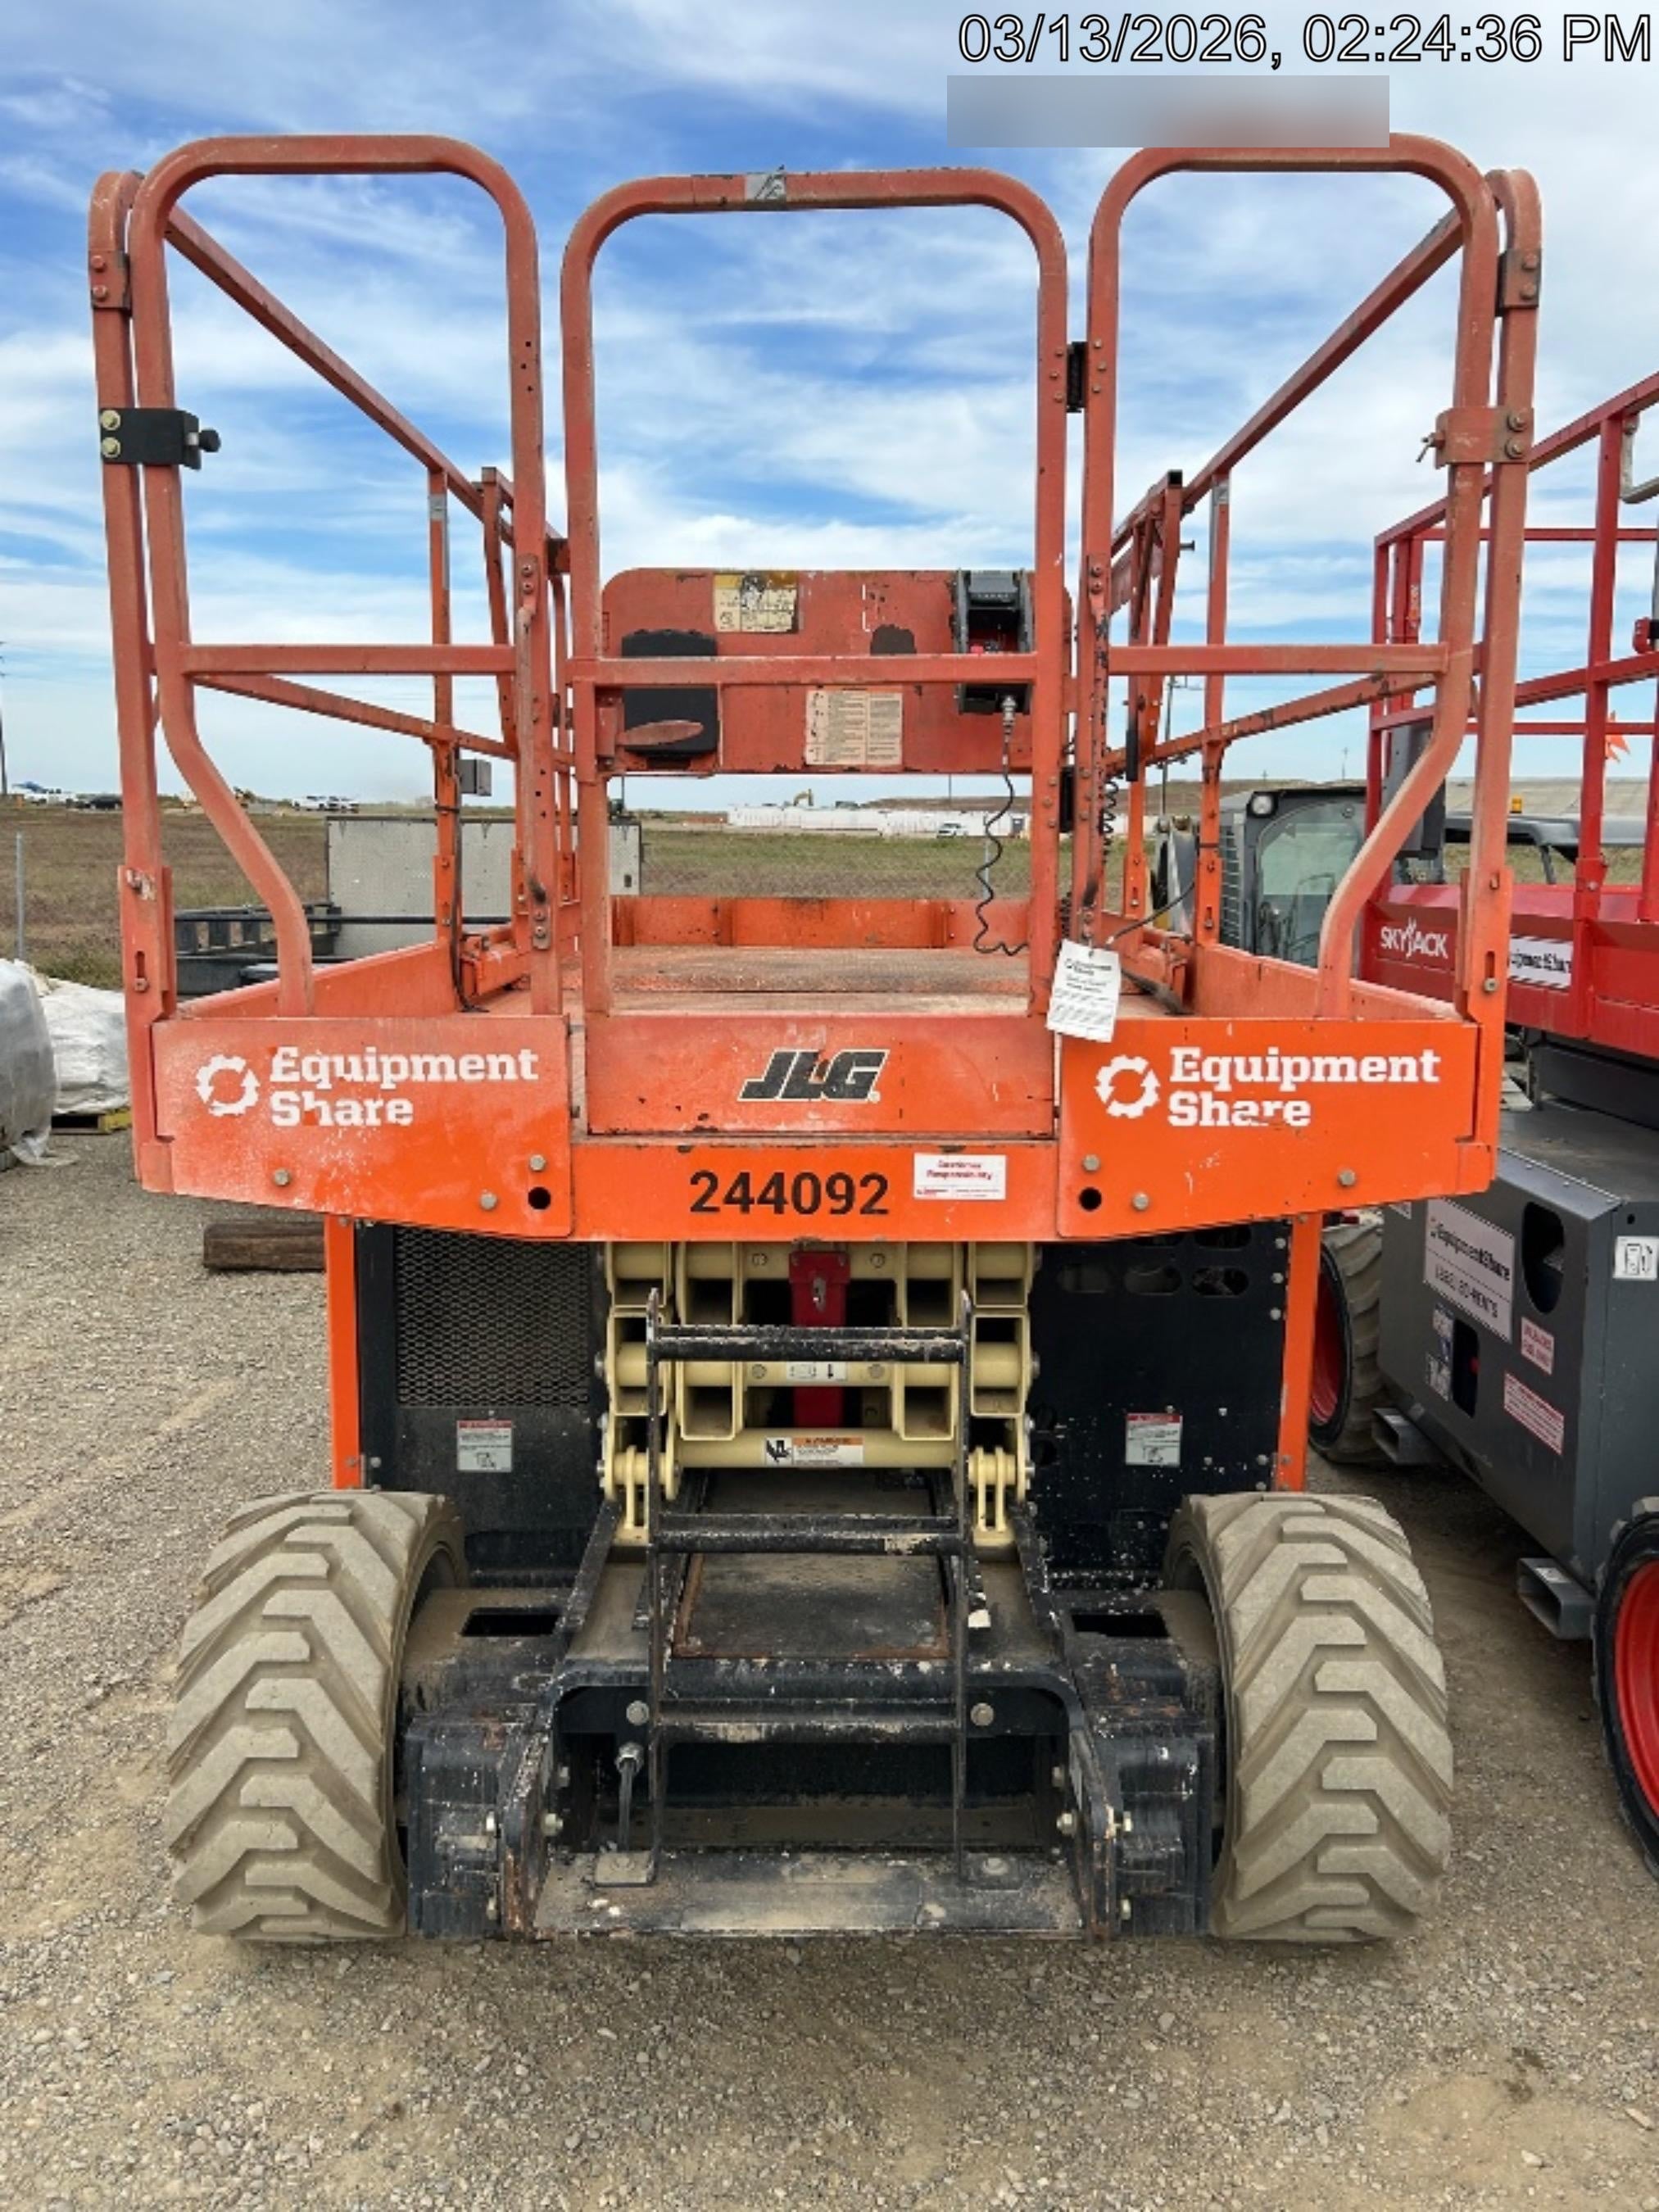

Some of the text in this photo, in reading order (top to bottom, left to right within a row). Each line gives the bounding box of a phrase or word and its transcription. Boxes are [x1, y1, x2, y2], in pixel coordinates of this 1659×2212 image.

[1380, 918, 1448, 959] SKYJACK
[270, 1046, 539, 1090] Equipment
[738, 1049, 891, 1103] JLG
[1169, 1046, 1442, 1092] Equipment
[270, 1090, 414, 1127] Share
[1167, 1091, 1312, 1127] Share
[689, 1169, 890, 1215] 244092
